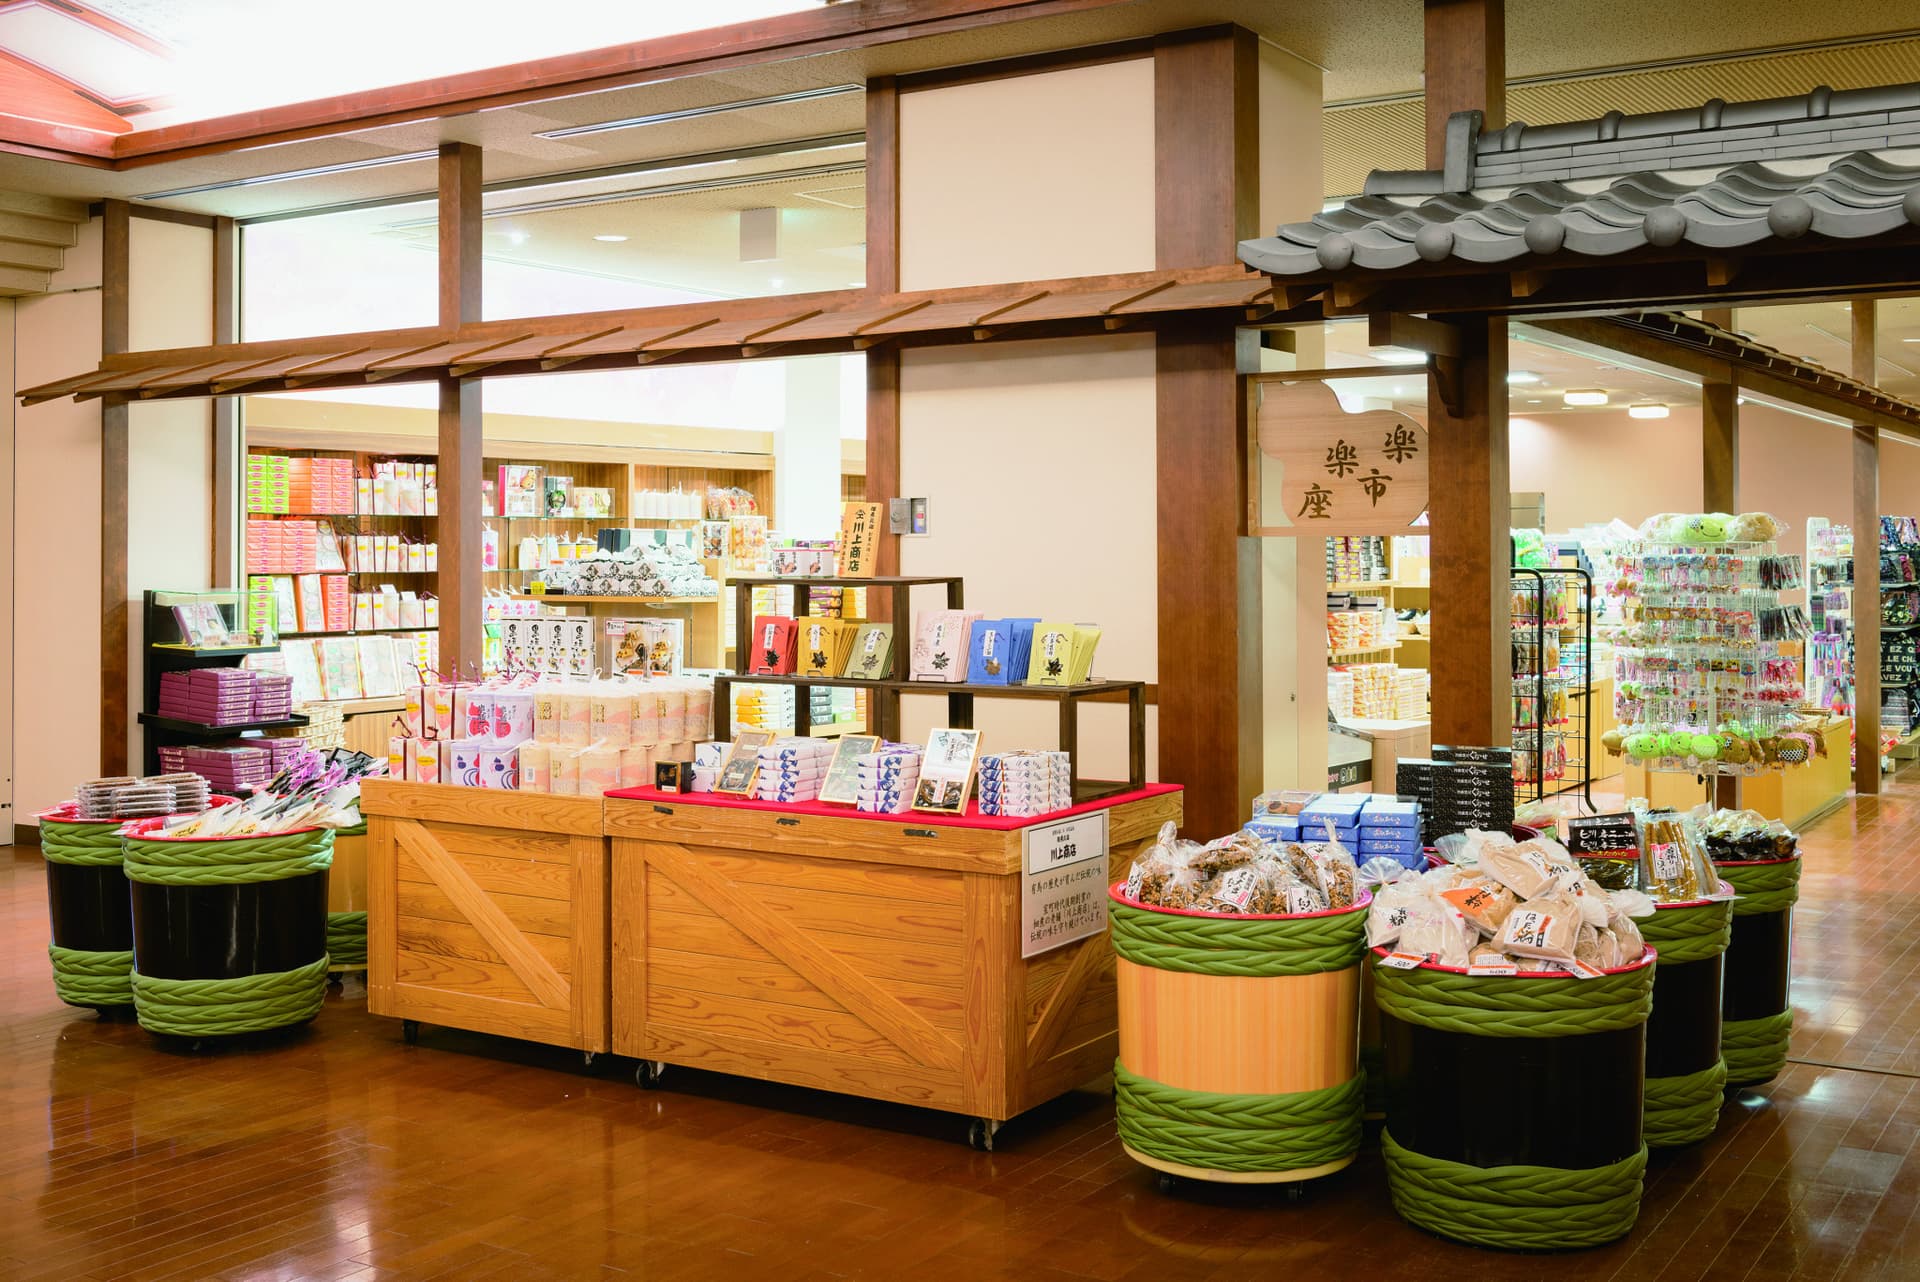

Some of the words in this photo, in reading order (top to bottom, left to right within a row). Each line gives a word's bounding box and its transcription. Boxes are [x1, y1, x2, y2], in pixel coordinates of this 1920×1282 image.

[1297, 424, 1418, 518] 楽市楽座
[848, 521, 864, 572] 川上商店
[1050, 843, 1077, 863] 川上商店
